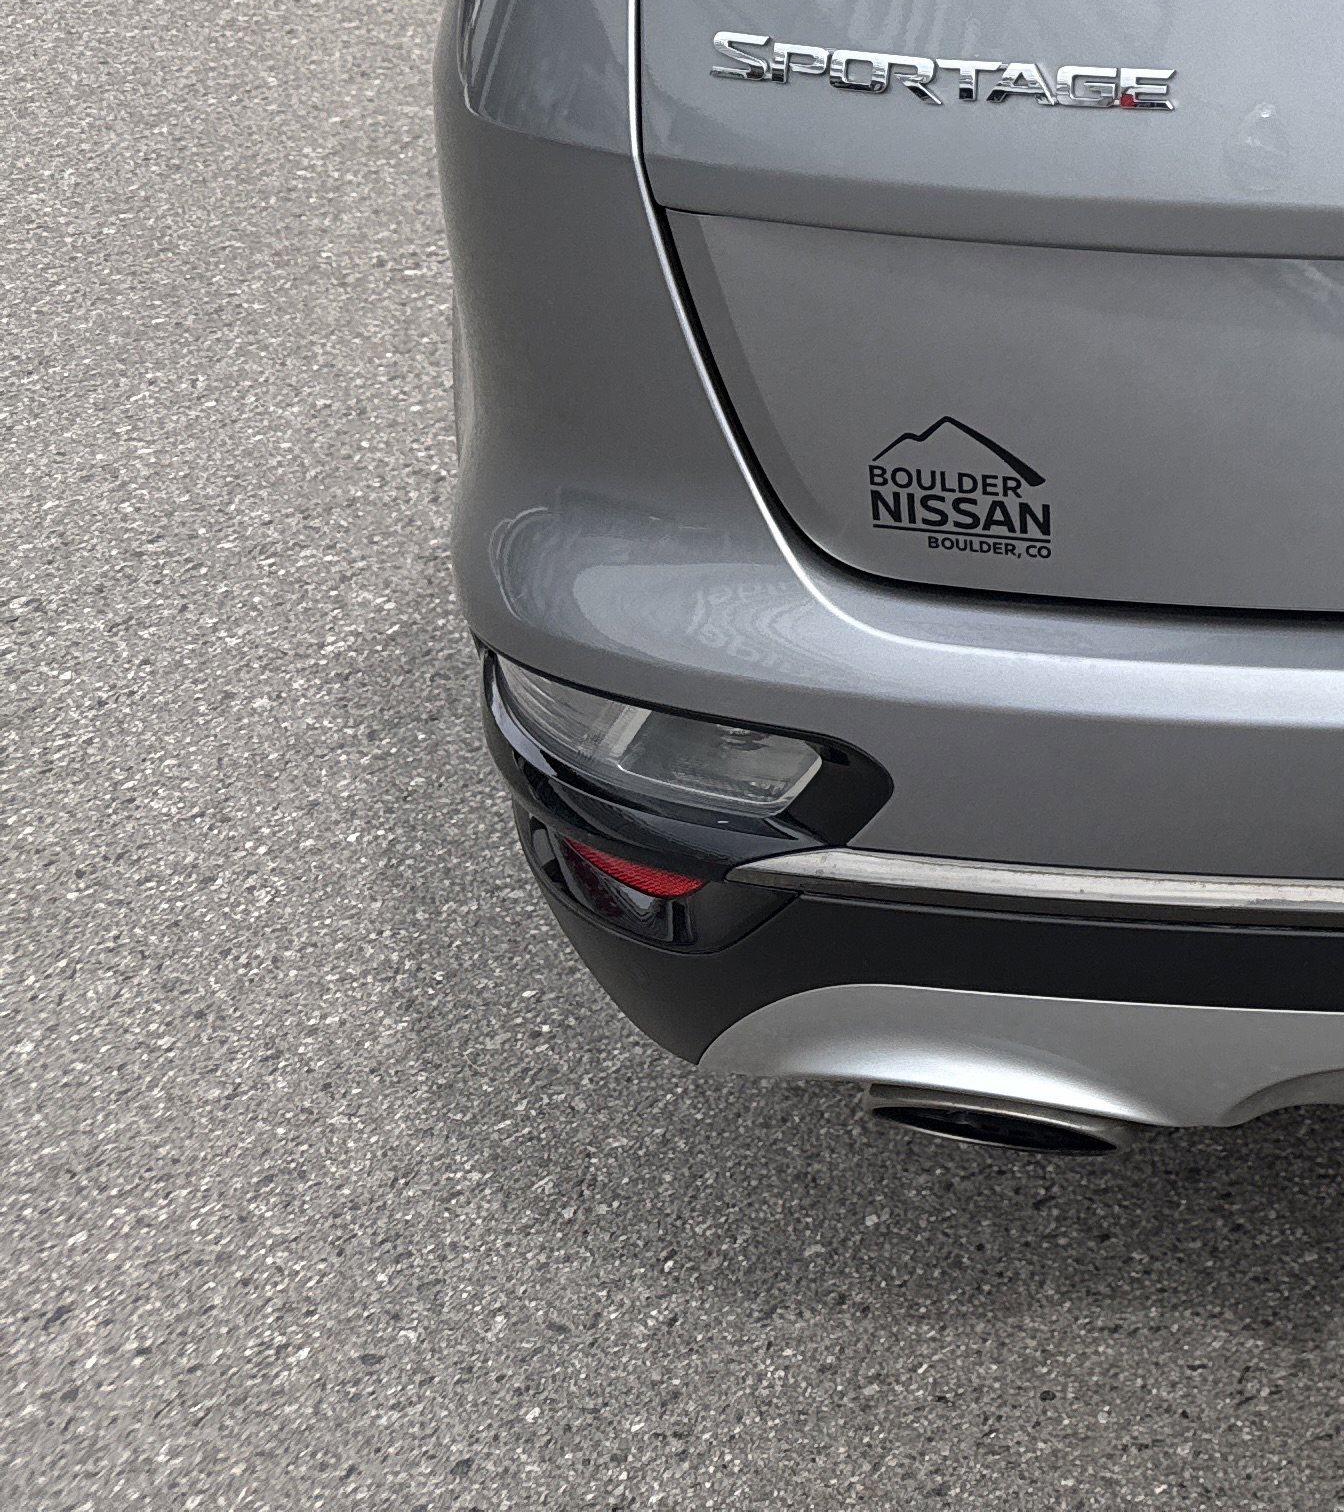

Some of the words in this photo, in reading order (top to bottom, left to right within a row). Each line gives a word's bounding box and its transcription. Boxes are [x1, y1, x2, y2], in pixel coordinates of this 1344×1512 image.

[709, 31, 1177, 111] SPORTAGE
[868, 464, 1023, 498] BOULDER
[870, 489, 1051, 536] NISSAN
[927, 535, 1022, 559] BOULDER,
[1025, 544, 1052, 559] CO
